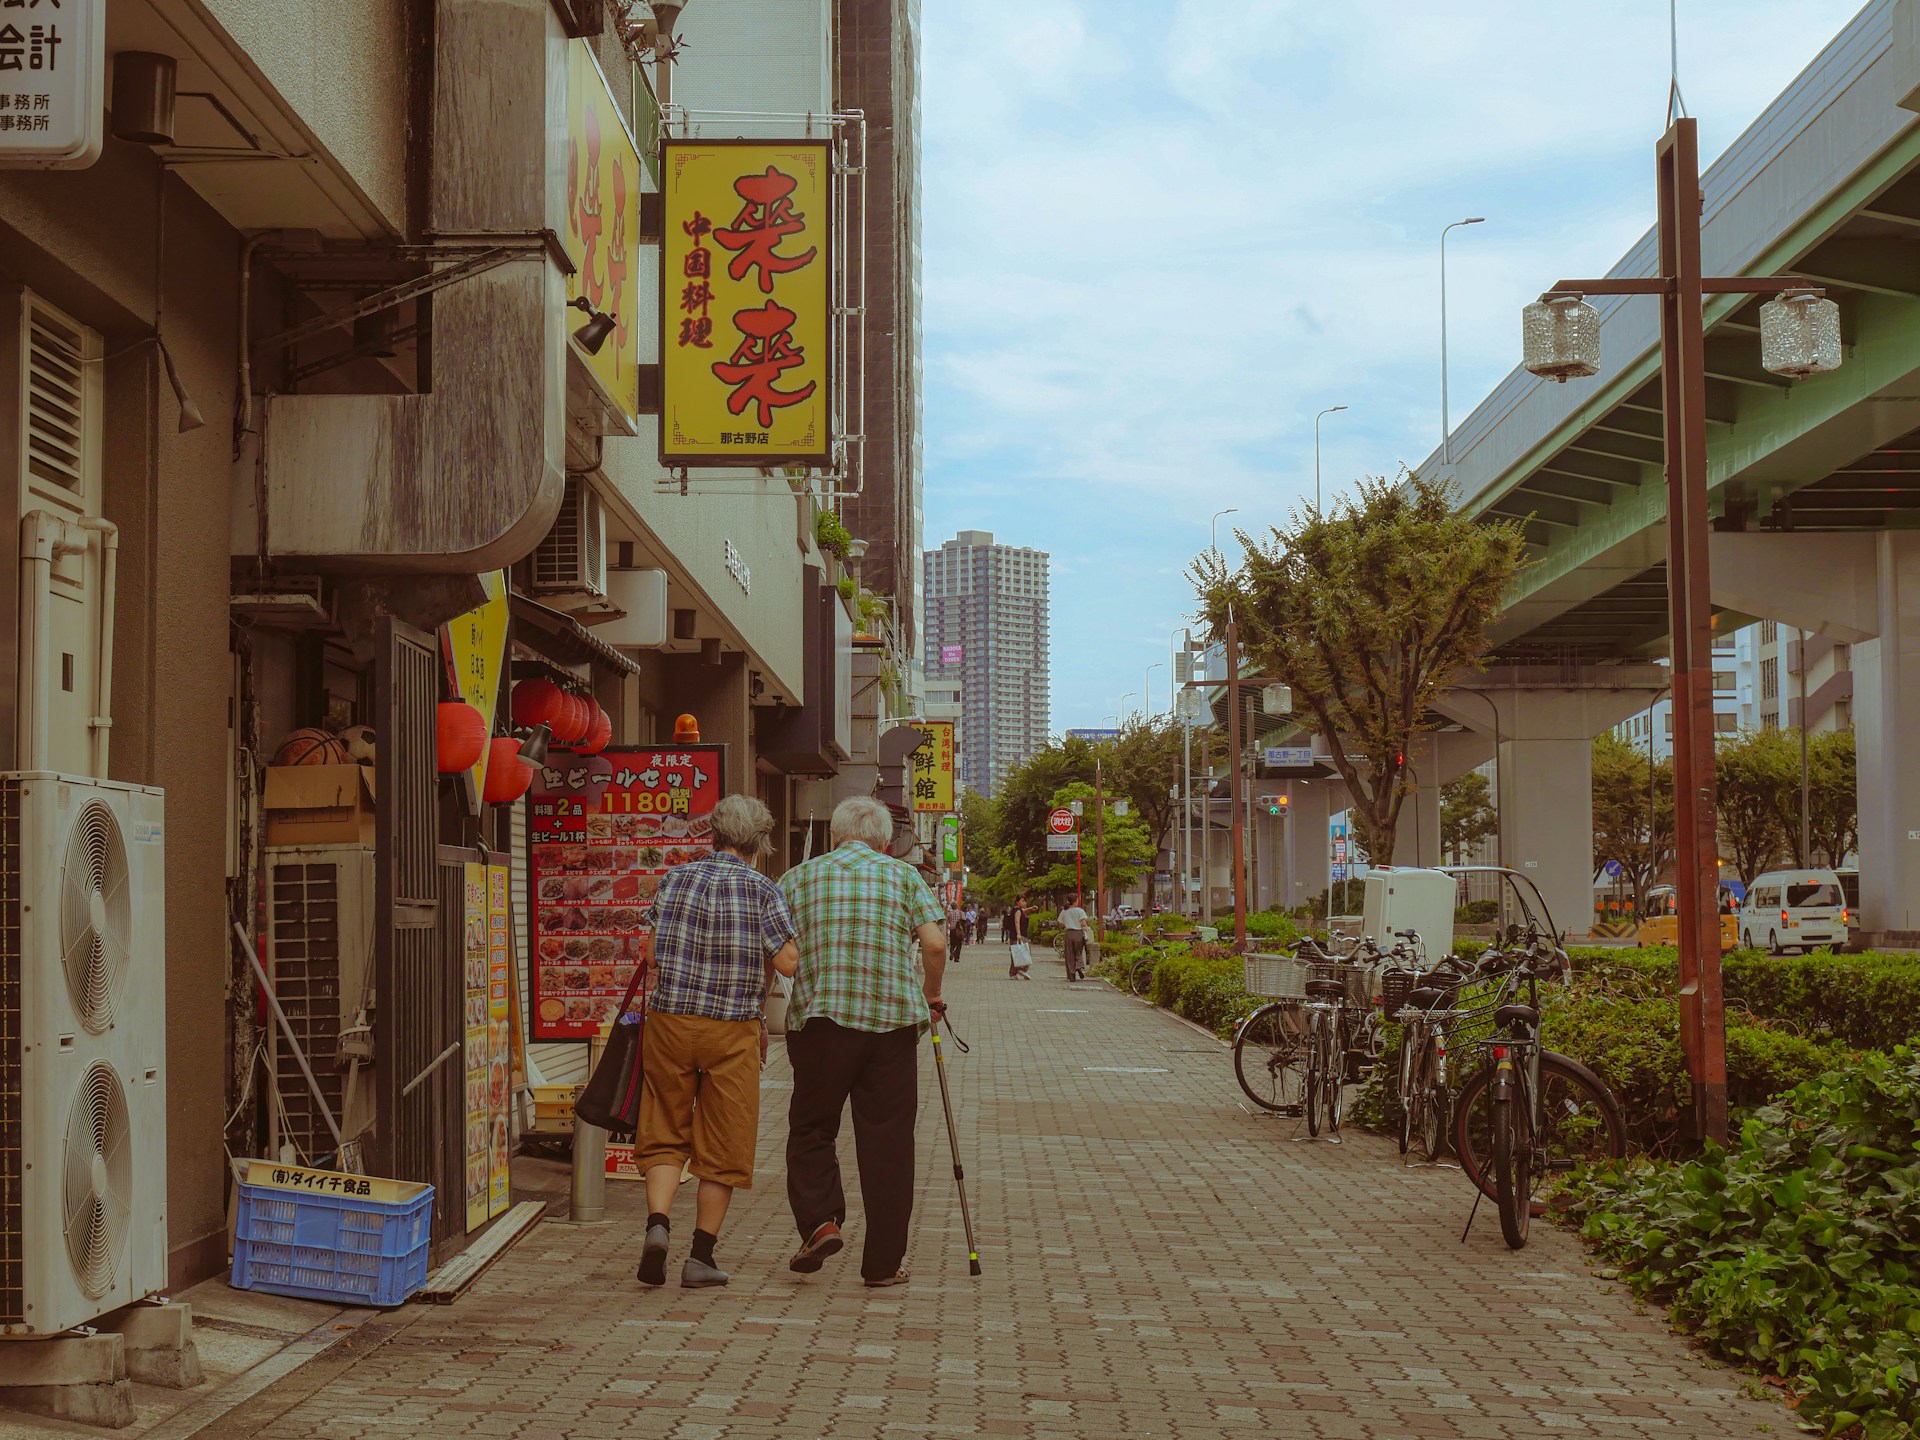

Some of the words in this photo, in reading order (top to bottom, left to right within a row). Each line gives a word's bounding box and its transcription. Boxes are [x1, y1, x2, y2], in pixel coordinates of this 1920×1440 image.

[0, 24, 61, 70] 会計
[0, 94, 50, 109] 事務所
[0, 115, 50, 130] 事務所
[678, 210, 714, 348] 中国料理
[720, 438, 769, 450] 那古野店
[471, 653, 485, 681] 日本酒
[941, 726, 951, 772] 台湾料理
[651, 754, 693, 767] 夜限定
[912, 727, 937, 800] 海鮮館
[541, 767, 708, 790] 生ビールセット
[603, 792, 690, 813] 1180円
[1053, 817, 1071, 826] 消火栓
[531, 831, 586, 843] 生ビール1杯
[272, 1169, 372, 1195] (有)ダイイチ食品
